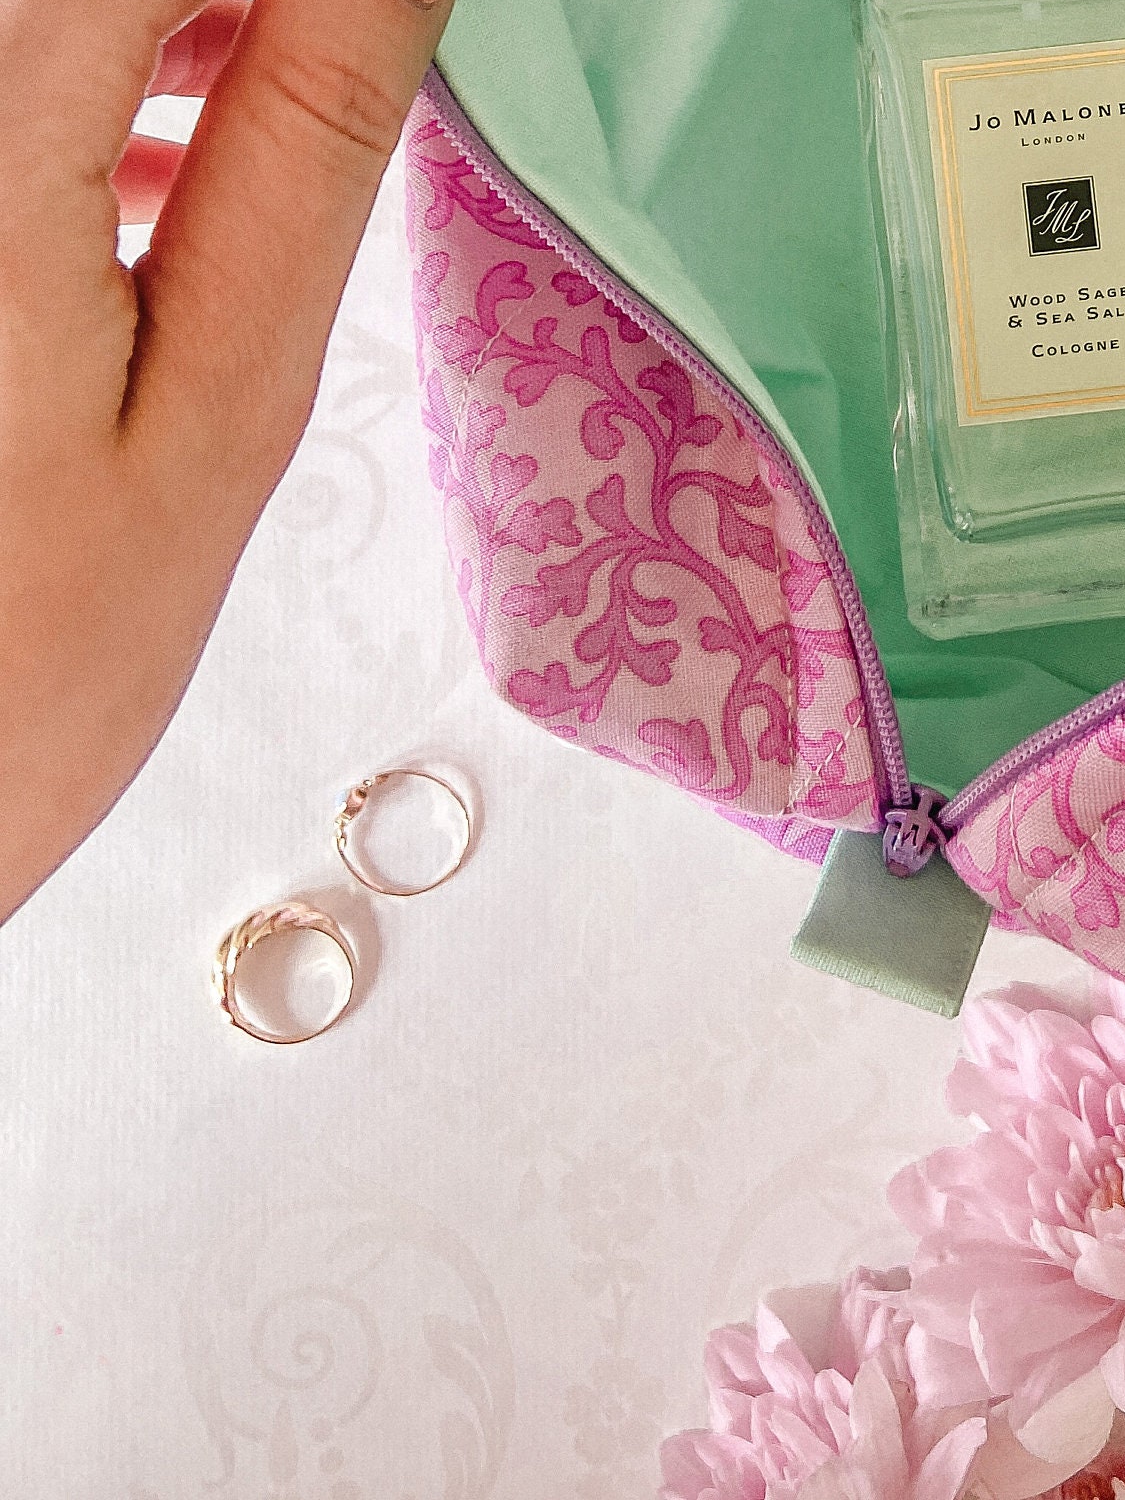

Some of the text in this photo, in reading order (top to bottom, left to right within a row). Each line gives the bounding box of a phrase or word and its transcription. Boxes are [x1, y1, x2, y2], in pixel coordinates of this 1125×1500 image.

[969, 113, 1001, 131] JO
[1021, 133, 1086, 147] LONDON
[1009, 294, 1066, 308] WOOD
[1007, 315, 1022, 329] &
[1036, 312, 1075, 326] SEA
[1031, 339, 1120, 358] COLOGNE
